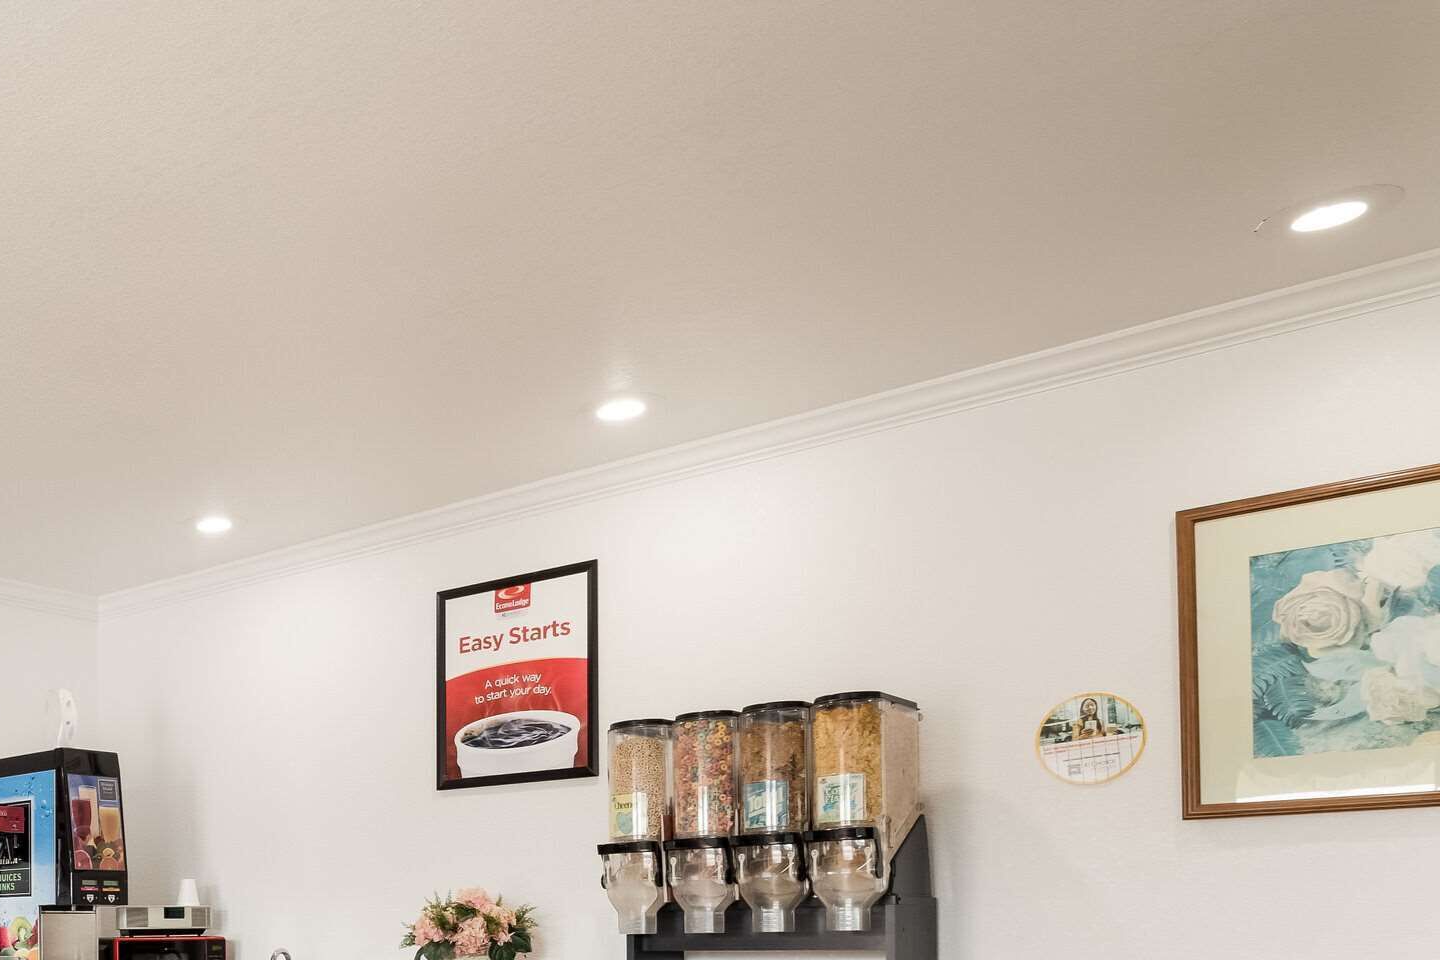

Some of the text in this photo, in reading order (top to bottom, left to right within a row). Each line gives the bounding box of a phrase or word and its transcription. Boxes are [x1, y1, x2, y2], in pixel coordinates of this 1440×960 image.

[459, 620, 571, 654] Easy Starts
[484, 673, 542, 689] A quick way
[474, 685, 552, 704] to start your day.
